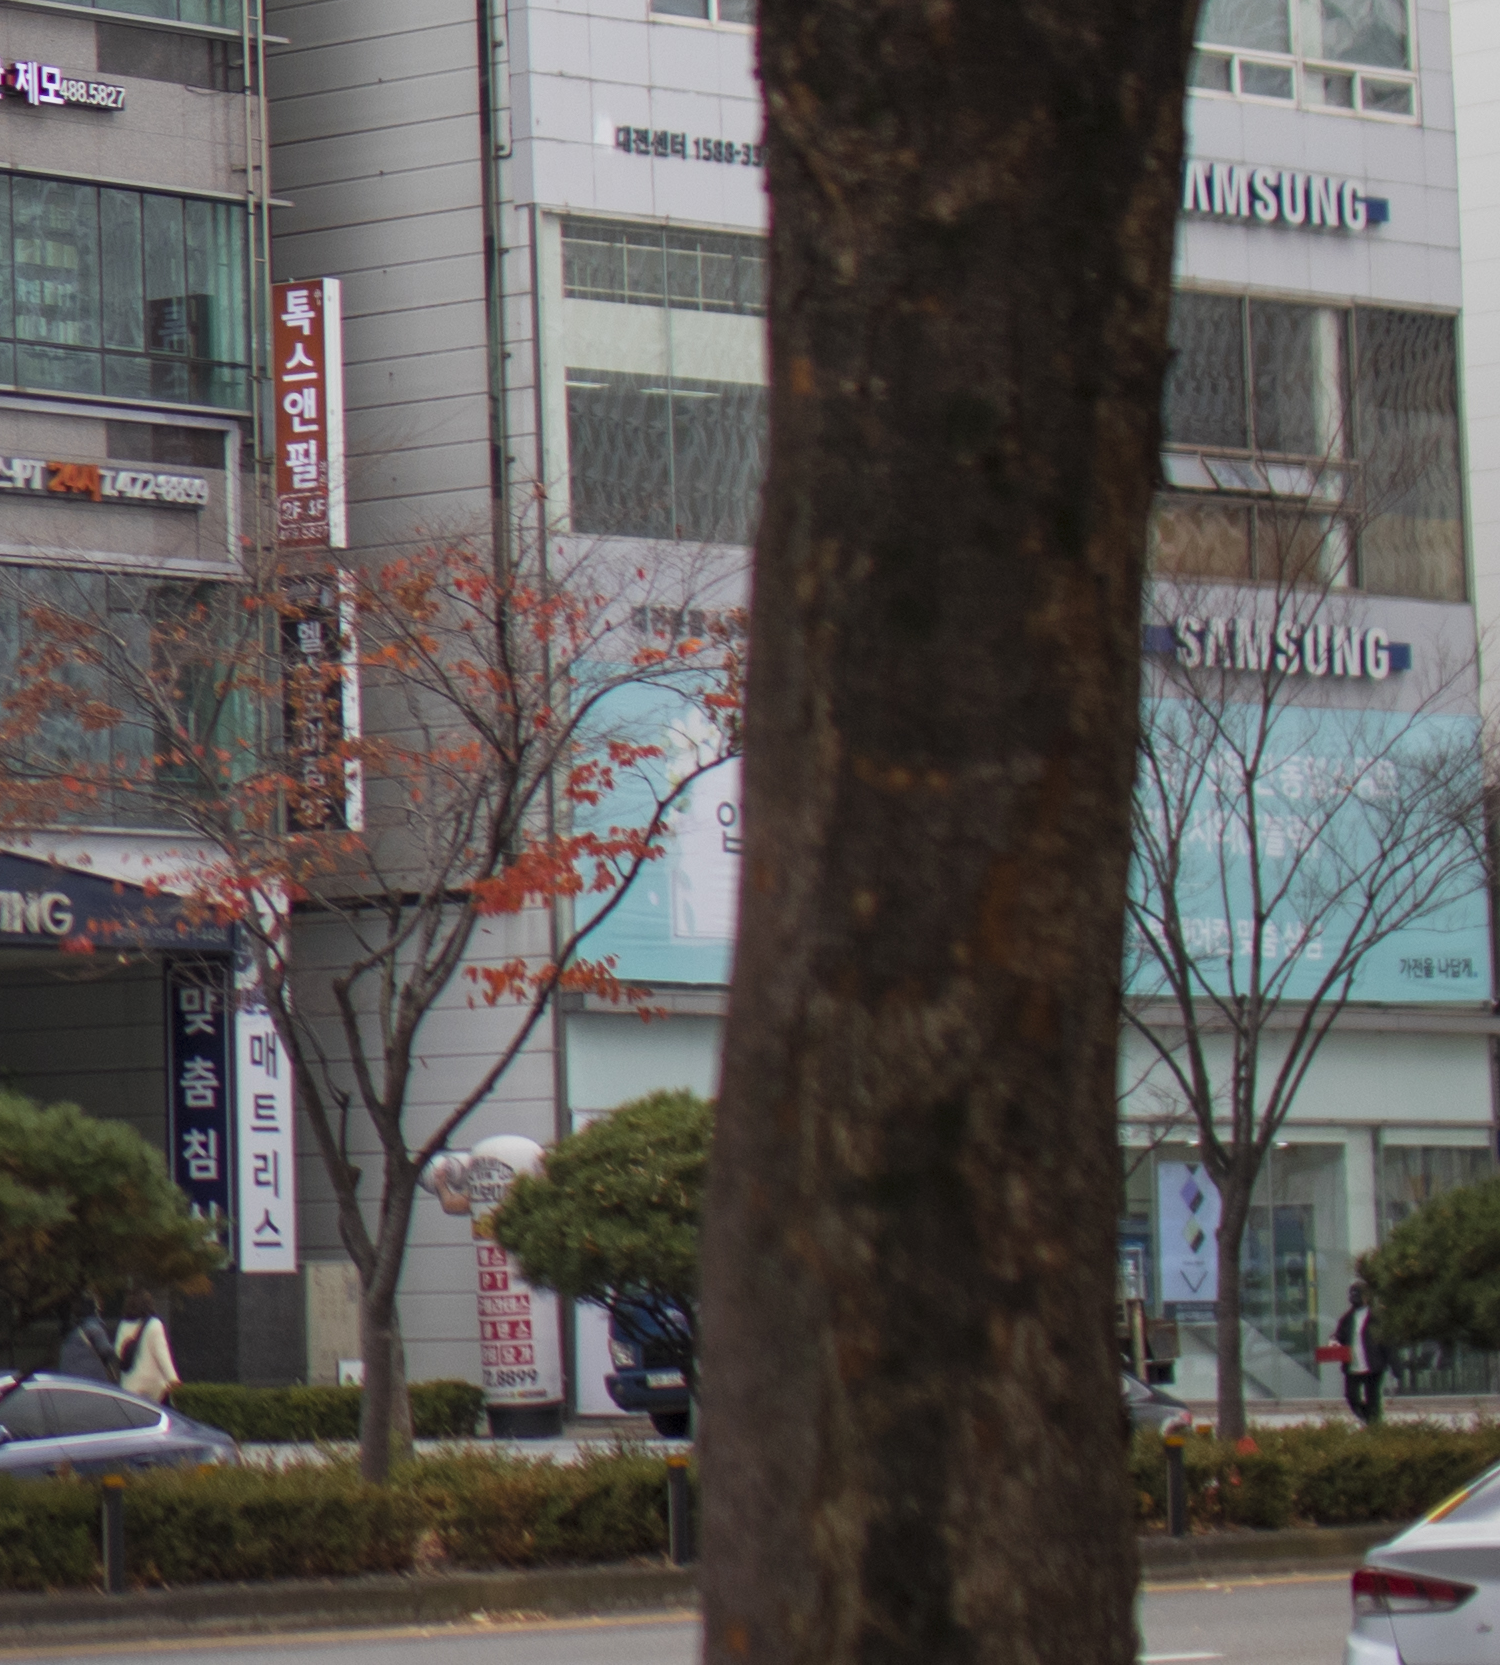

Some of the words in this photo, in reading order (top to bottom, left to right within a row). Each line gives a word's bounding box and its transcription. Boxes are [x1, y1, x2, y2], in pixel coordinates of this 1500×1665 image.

[13, 60, 66, 106] 제모
[58, 78, 127, 111] 488.5827
[614, 124, 687, 160] 대전센터
[1182, 160, 1370, 230] AMSUNG
[280, 288, 320, 491] 톡스앤필
[1175, 615, 1391, 680] SAMSUNG
[249, 1030, 283, 1249] 매트리스
